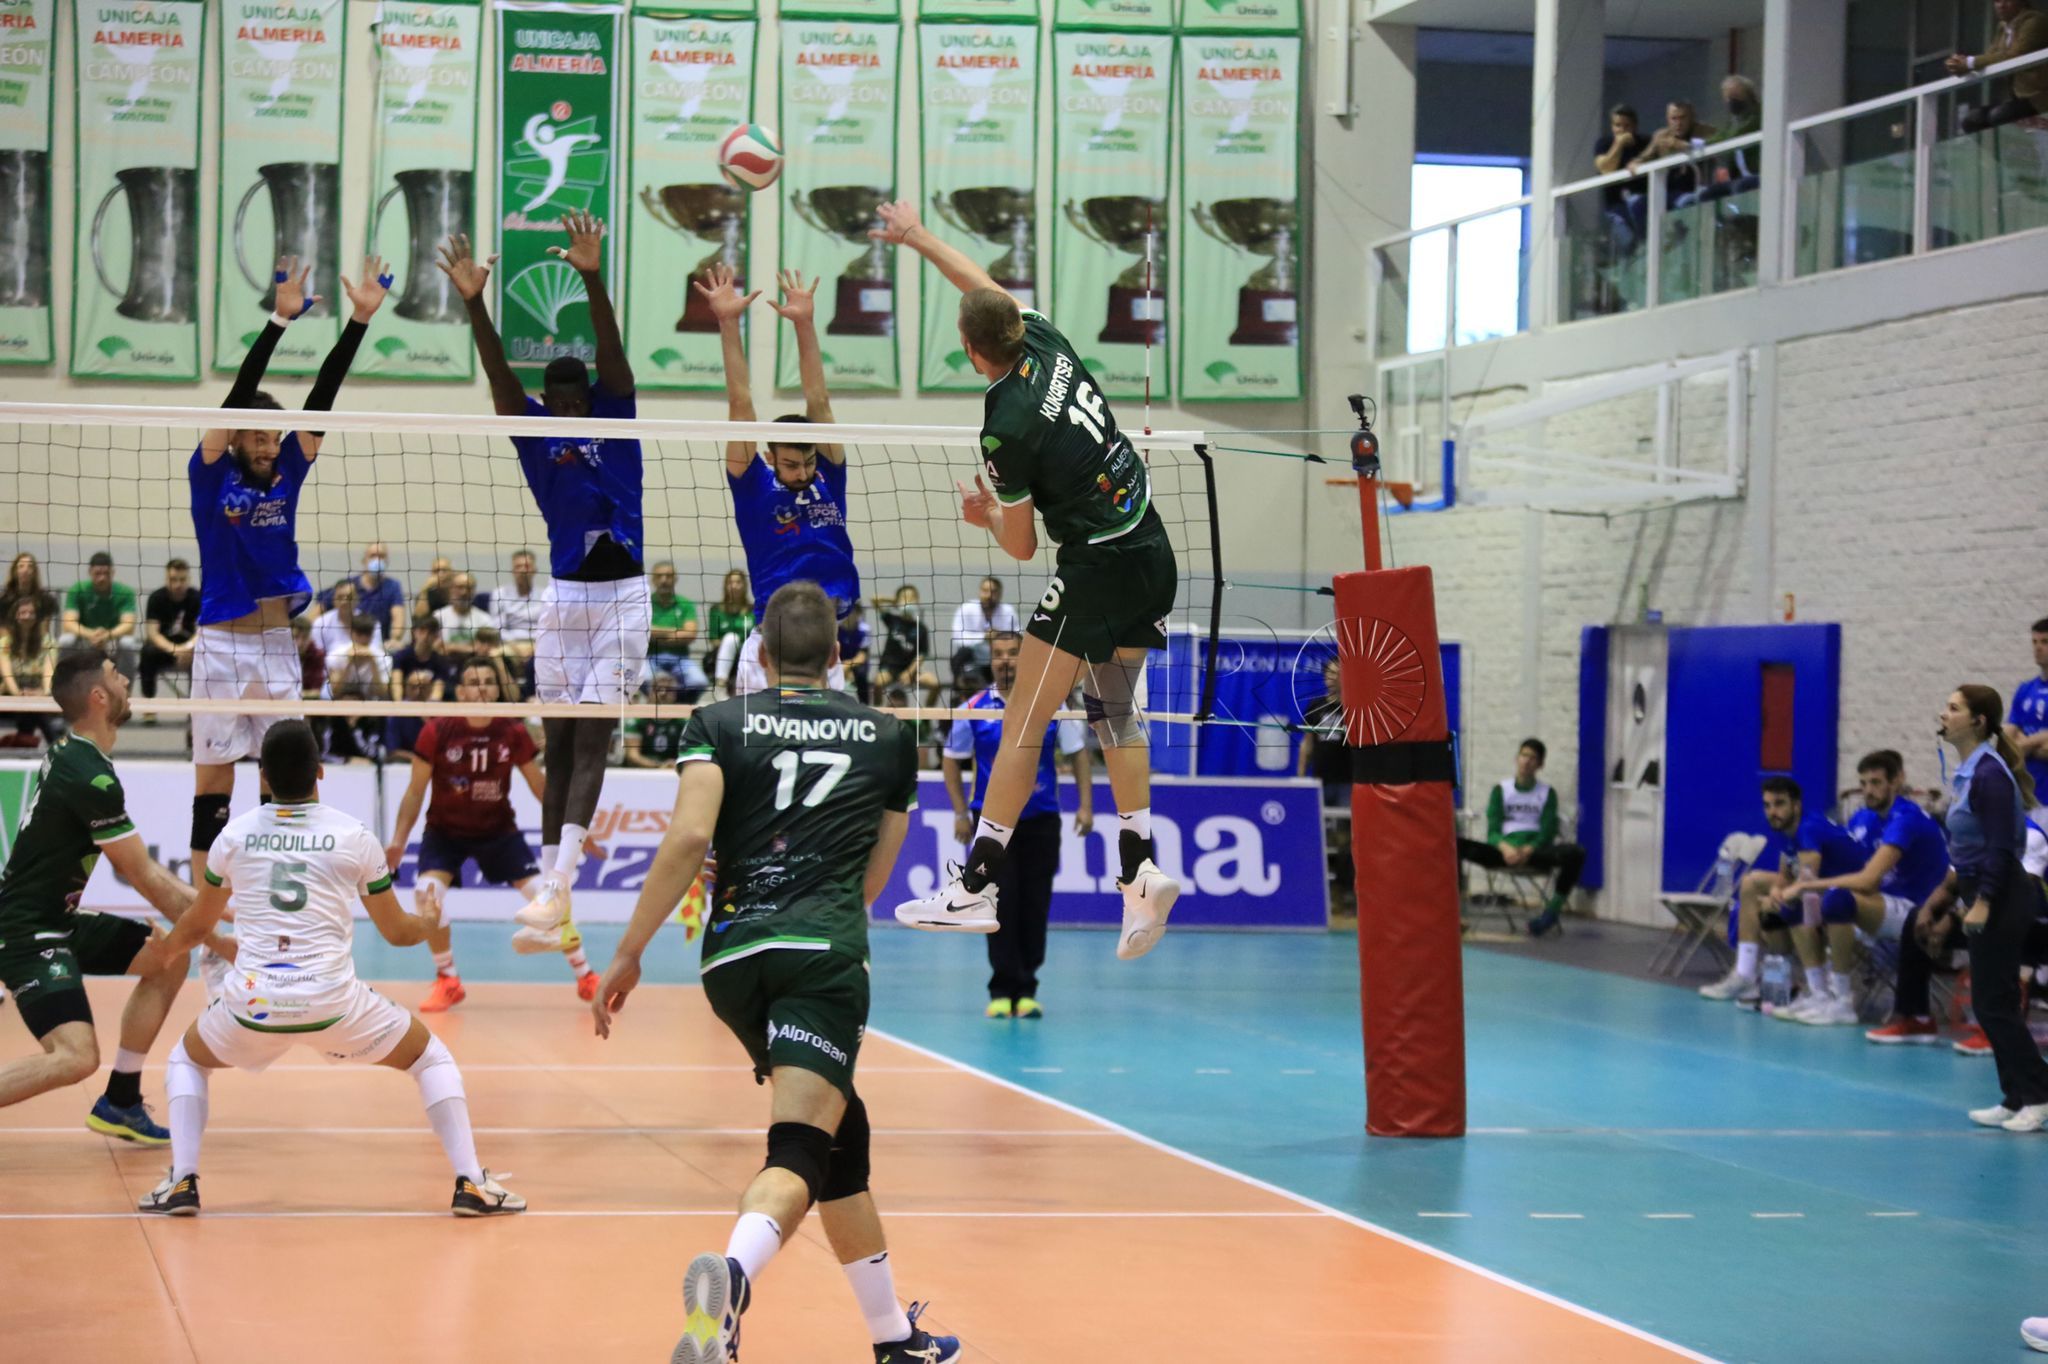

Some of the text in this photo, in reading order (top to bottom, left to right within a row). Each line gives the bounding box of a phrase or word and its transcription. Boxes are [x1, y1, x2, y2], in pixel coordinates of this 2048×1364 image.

[99, 9, 180, 25] UNICAJA
[242, 6, 321, 22] UNICAJA
[384, 11, 458, 28] UNICAJA
[1236, 6, 1278, 17] Unicaja
[93, 30, 184, 47] ALMERÍA
[237, 26, 325, 43] ALMERÍA
[515, 29, 601, 50] UNICAJA
[655, 29, 733, 45] UNICAJA
[801, 32, 878, 47] UNICAJA
[940, 34, 1016, 49] UNICAJA
[650, 48, 736, 66] ALMERÍA
[796, 51, 880, 68] ALMERÍA
[1075, 43, 1152, 59] UNICAJA
[1202, 46, 1278, 61] UNICAJA
[509, 53, 606, 75] ALMERÍA
[936, 54, 1020, 69] ALMERÍA
[1071, 63, 1155, 80] ALMERÍA
[1197, 65, 1282, 82] ALMERÍA
[1235, 373, 1278, 386] Unicaja
[742, 712, 877, 743] JOVANOVIC
[470, 748, 488, 772] 11
[772, 750, 852, 811] 17
[244, 834, 336, 852] PAQUILLO
[269, 862, 308, 912] 5
[778, 1024, 848, 1066] Alprosan
